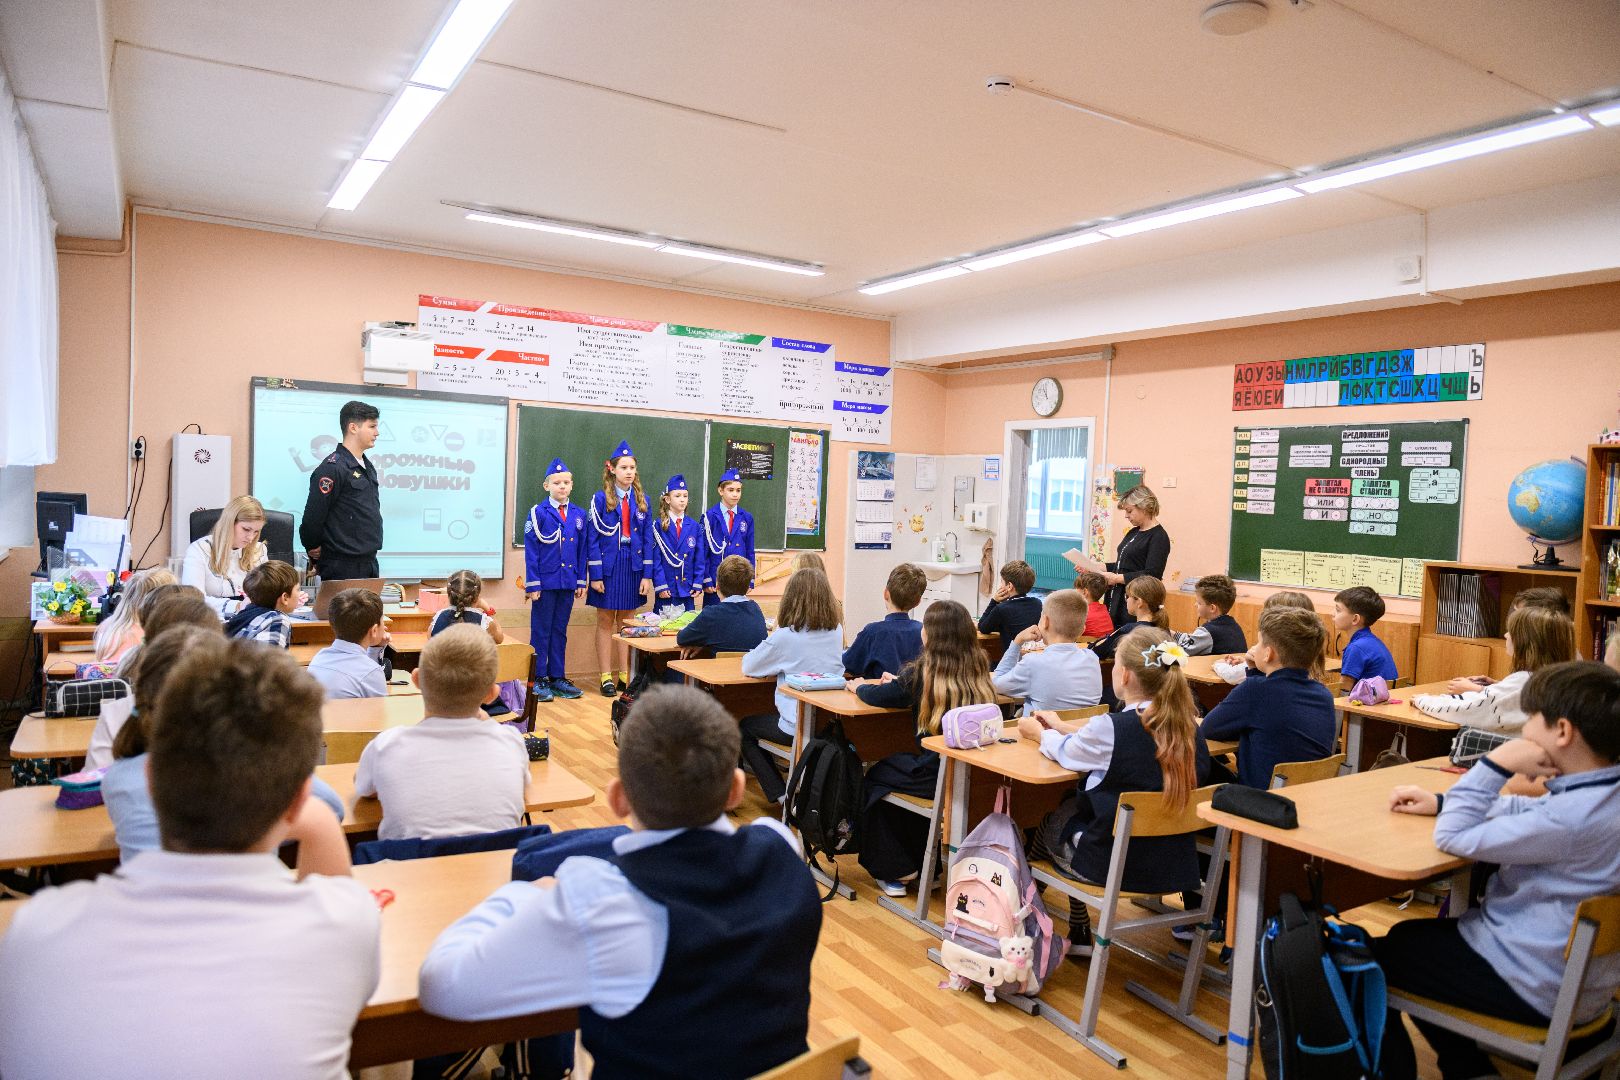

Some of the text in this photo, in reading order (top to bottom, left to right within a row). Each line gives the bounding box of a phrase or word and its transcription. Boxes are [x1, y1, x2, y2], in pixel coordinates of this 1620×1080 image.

[432, 296, 457, 307] Сумма
[467, 318, 475, 326] 12
[526, 325, 534, 333] 14
[518, 352, 545, 363] Частное
[1342, 431, 1389, 440] ПРЕДЛОЖЕНИЯ
[371, 453, 476, 474] орожные
[1341, 457, 1386, 465] ОДНОРОДНЫЕ
[1354, 469, 1377, 477] ЧЛЕНЫ
[1362, 480, 1391, 488] ЗАПЯТАЯ
[1359, 488, 1392, 496] СТАВИТСЯ
[1321, 511, 1328, 519] И
